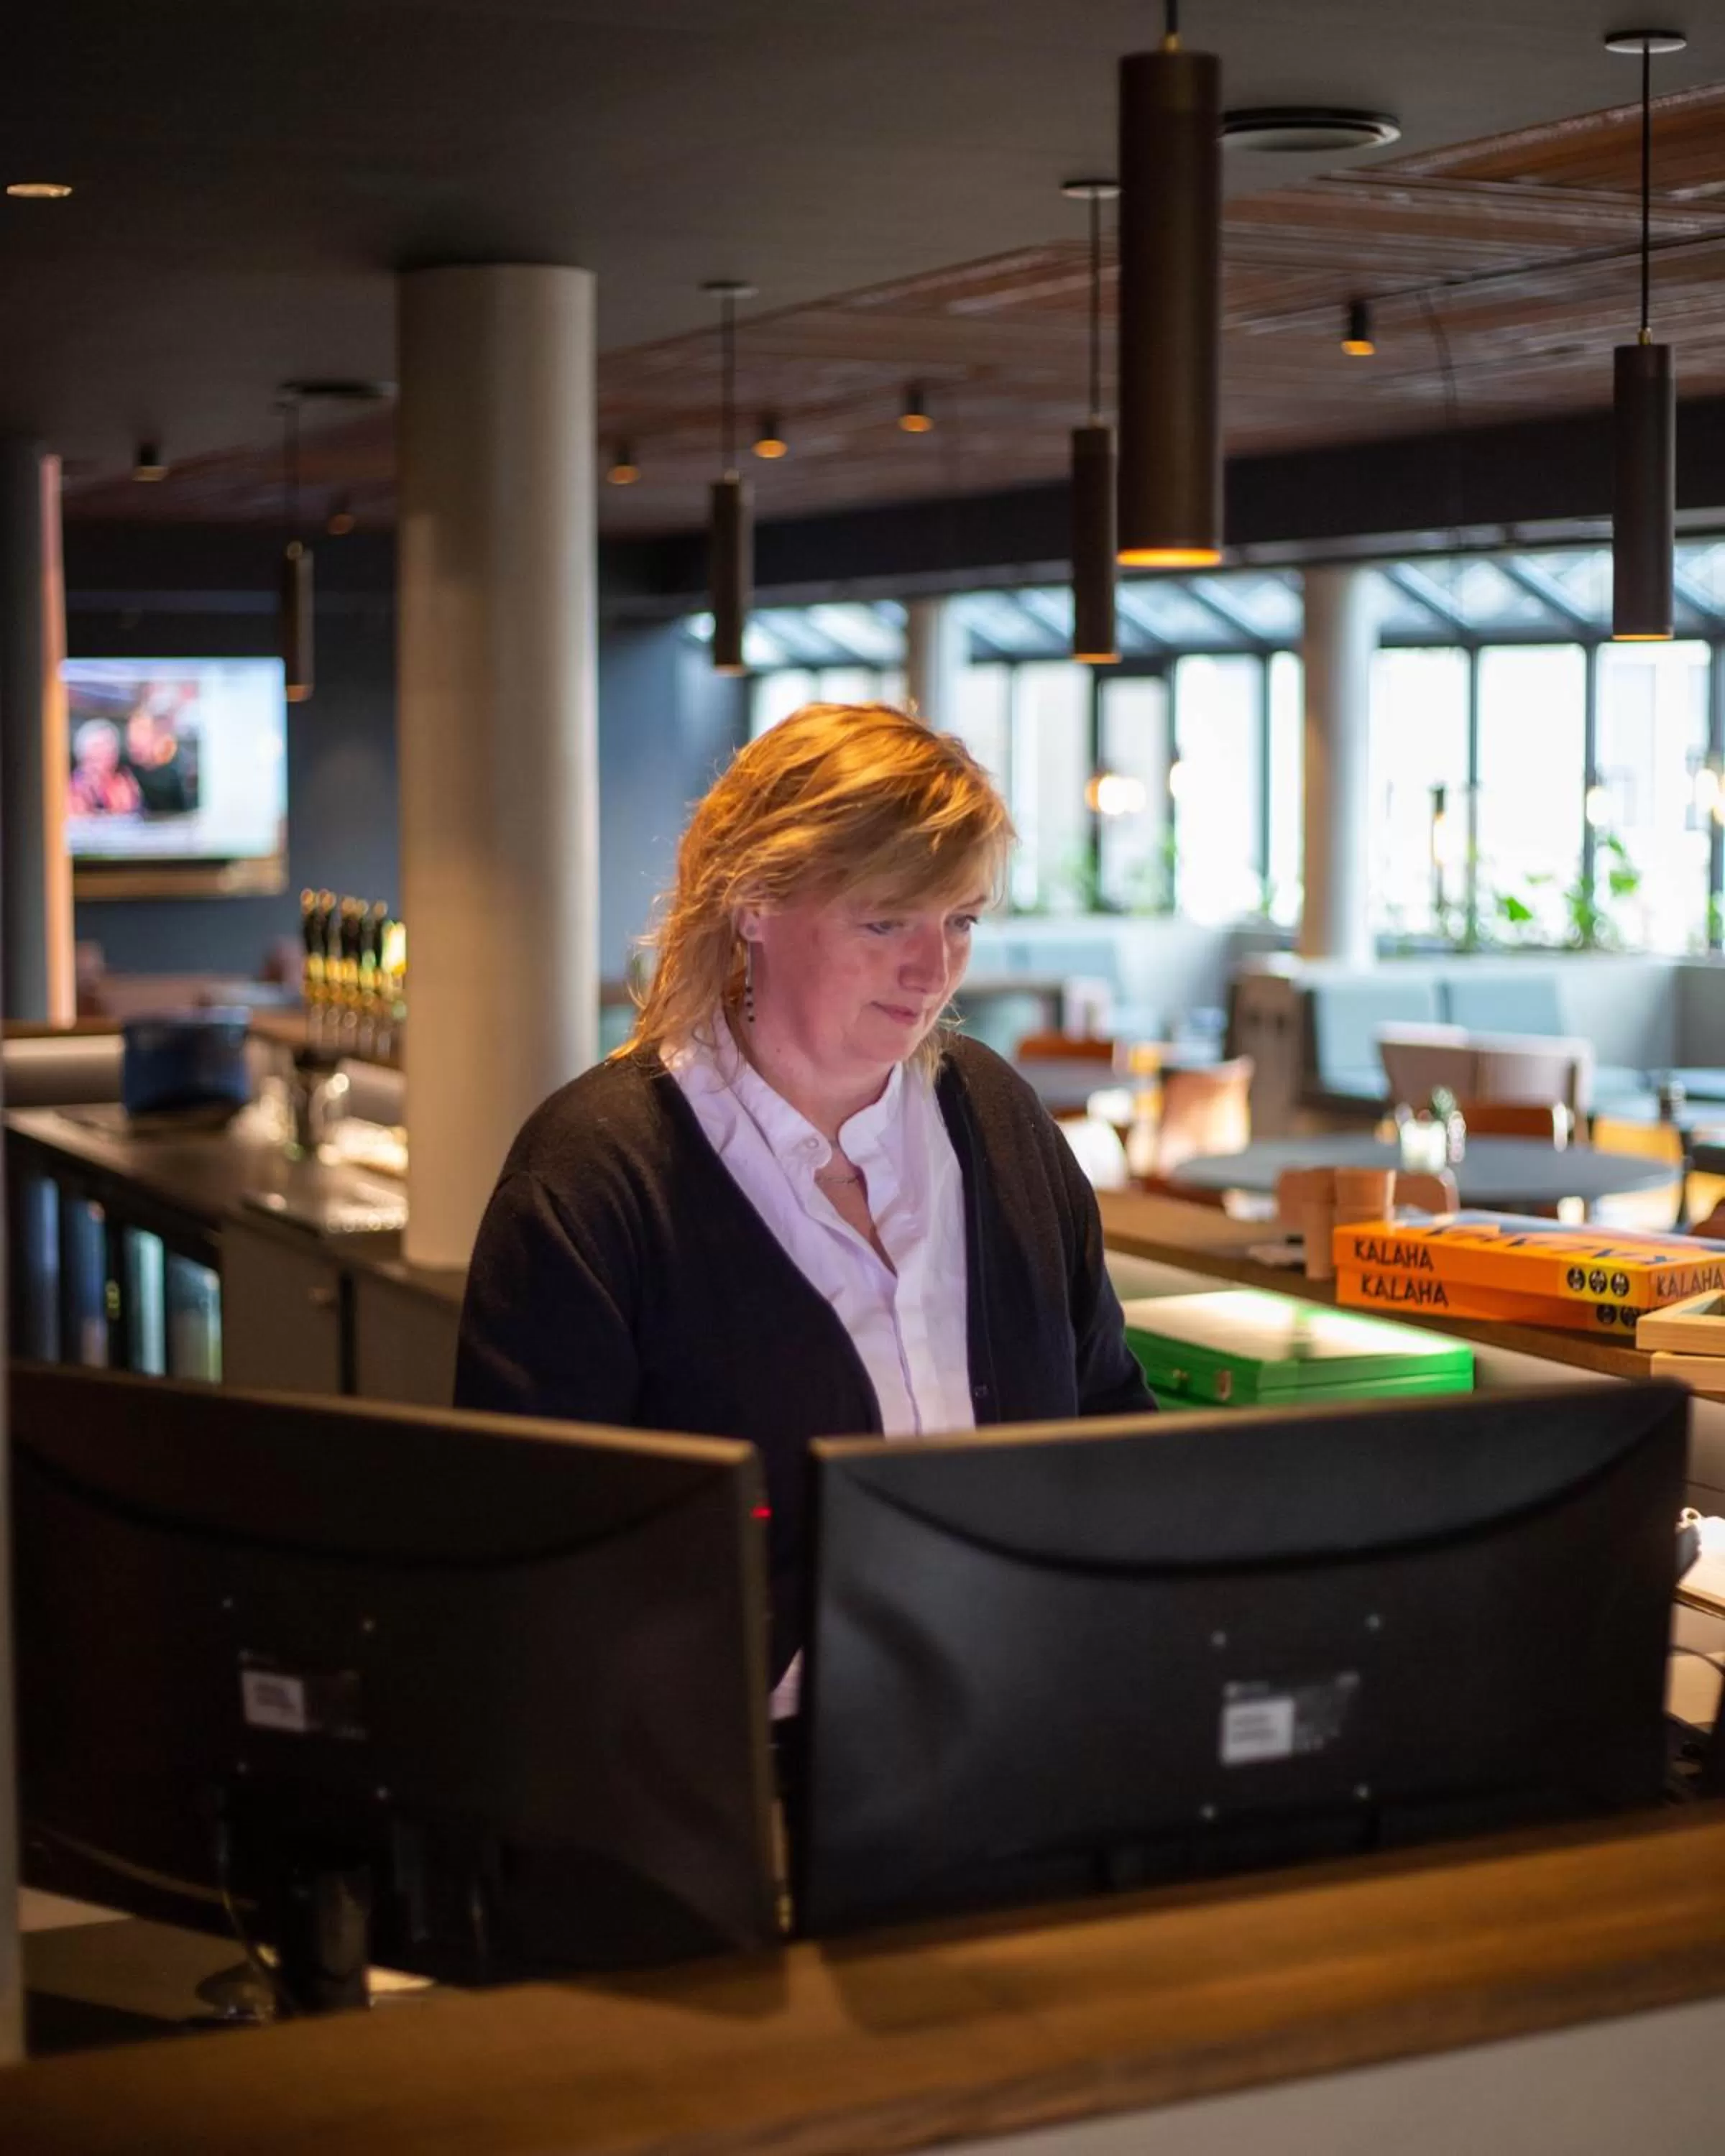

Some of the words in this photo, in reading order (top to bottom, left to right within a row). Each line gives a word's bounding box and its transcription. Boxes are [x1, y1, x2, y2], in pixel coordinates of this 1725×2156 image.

[1355, 1237, 1435, 1272] KALAHA
[1361, 1273, 1450, 1309] KALAHA
[1656, 1266, 1725, 1298] KALAHA
